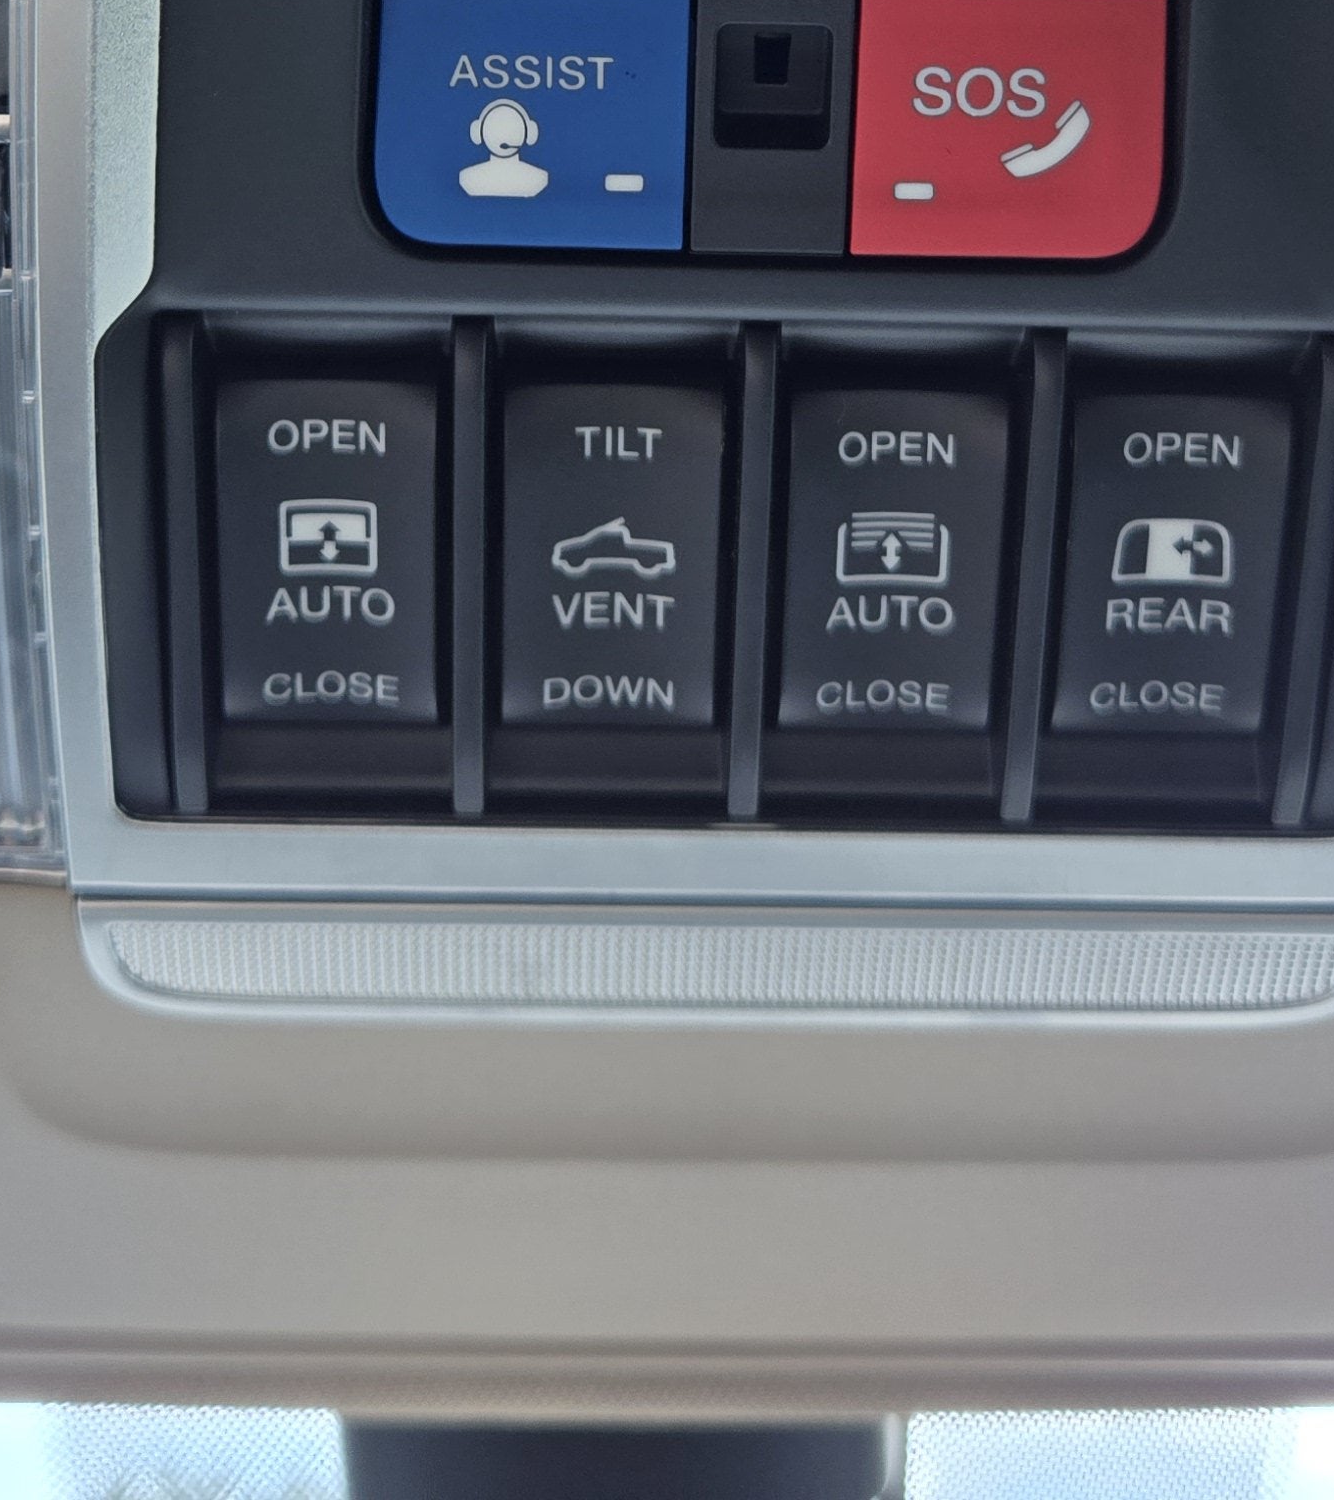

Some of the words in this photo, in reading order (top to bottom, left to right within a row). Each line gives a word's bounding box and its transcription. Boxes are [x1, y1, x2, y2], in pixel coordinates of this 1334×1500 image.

[449, 55, 614, 91] ASSIST
[913, 66, 1047, 117] SOS
[268, 418, 387, 454] OPEN
[575, 425, 663, 461] TILT
[837, 431, 955, 466] OPEN
[1123, 432, 1241, 467] OPEN
[266, 585, 396, 624] AUTO
[552, 591, 676, 630] VENT
[825, 595, 954, 633] AUTO
[1105, 597, 1233, 635] REAR
[263, 670, 401, 703] CLOSE
[542, 674, 675, 711] DOWN
[815, 680, 951, 714] CLOSE
[1089, 681, 1226, 715] CLOSE
